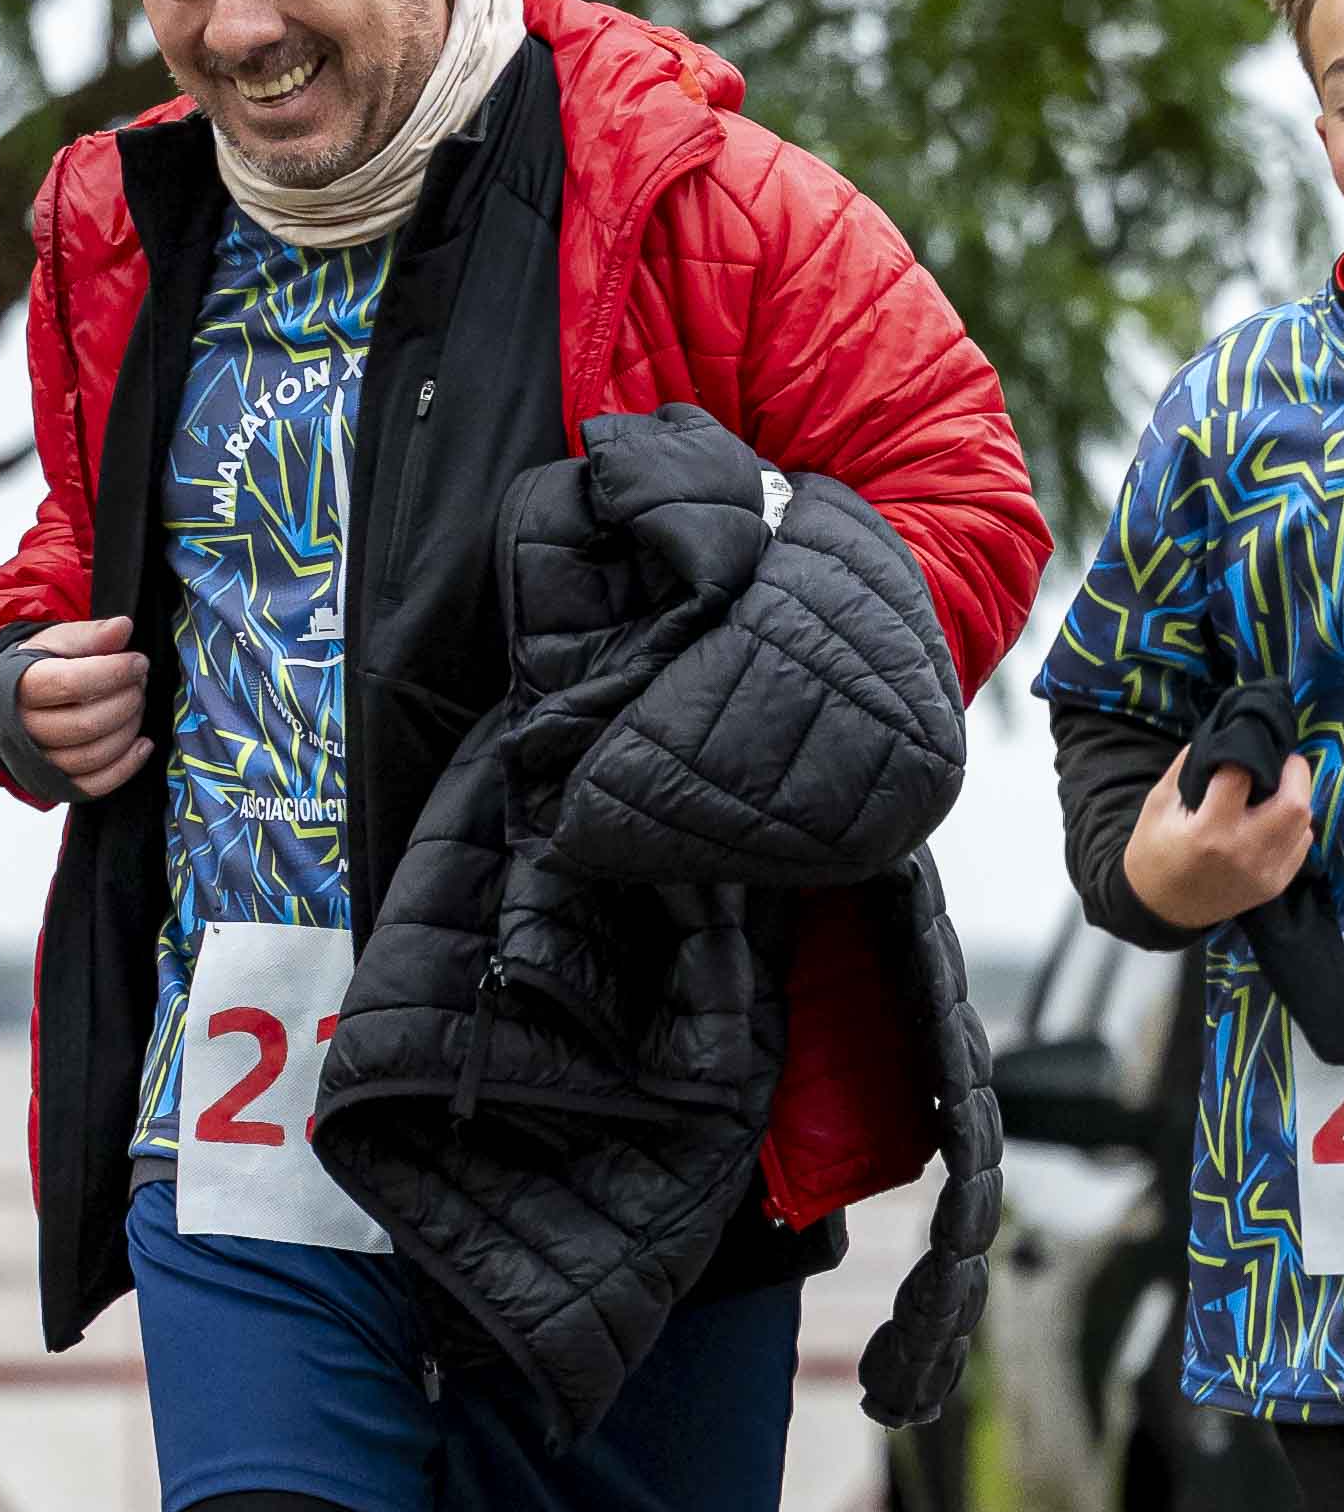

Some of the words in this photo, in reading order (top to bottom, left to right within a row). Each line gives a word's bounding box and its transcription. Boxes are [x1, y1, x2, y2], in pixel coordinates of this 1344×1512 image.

[213, 360, 330, 520] MARATÓN
[340, 352, 364, 381] X
[195, 1006, 342, 1147] 2
